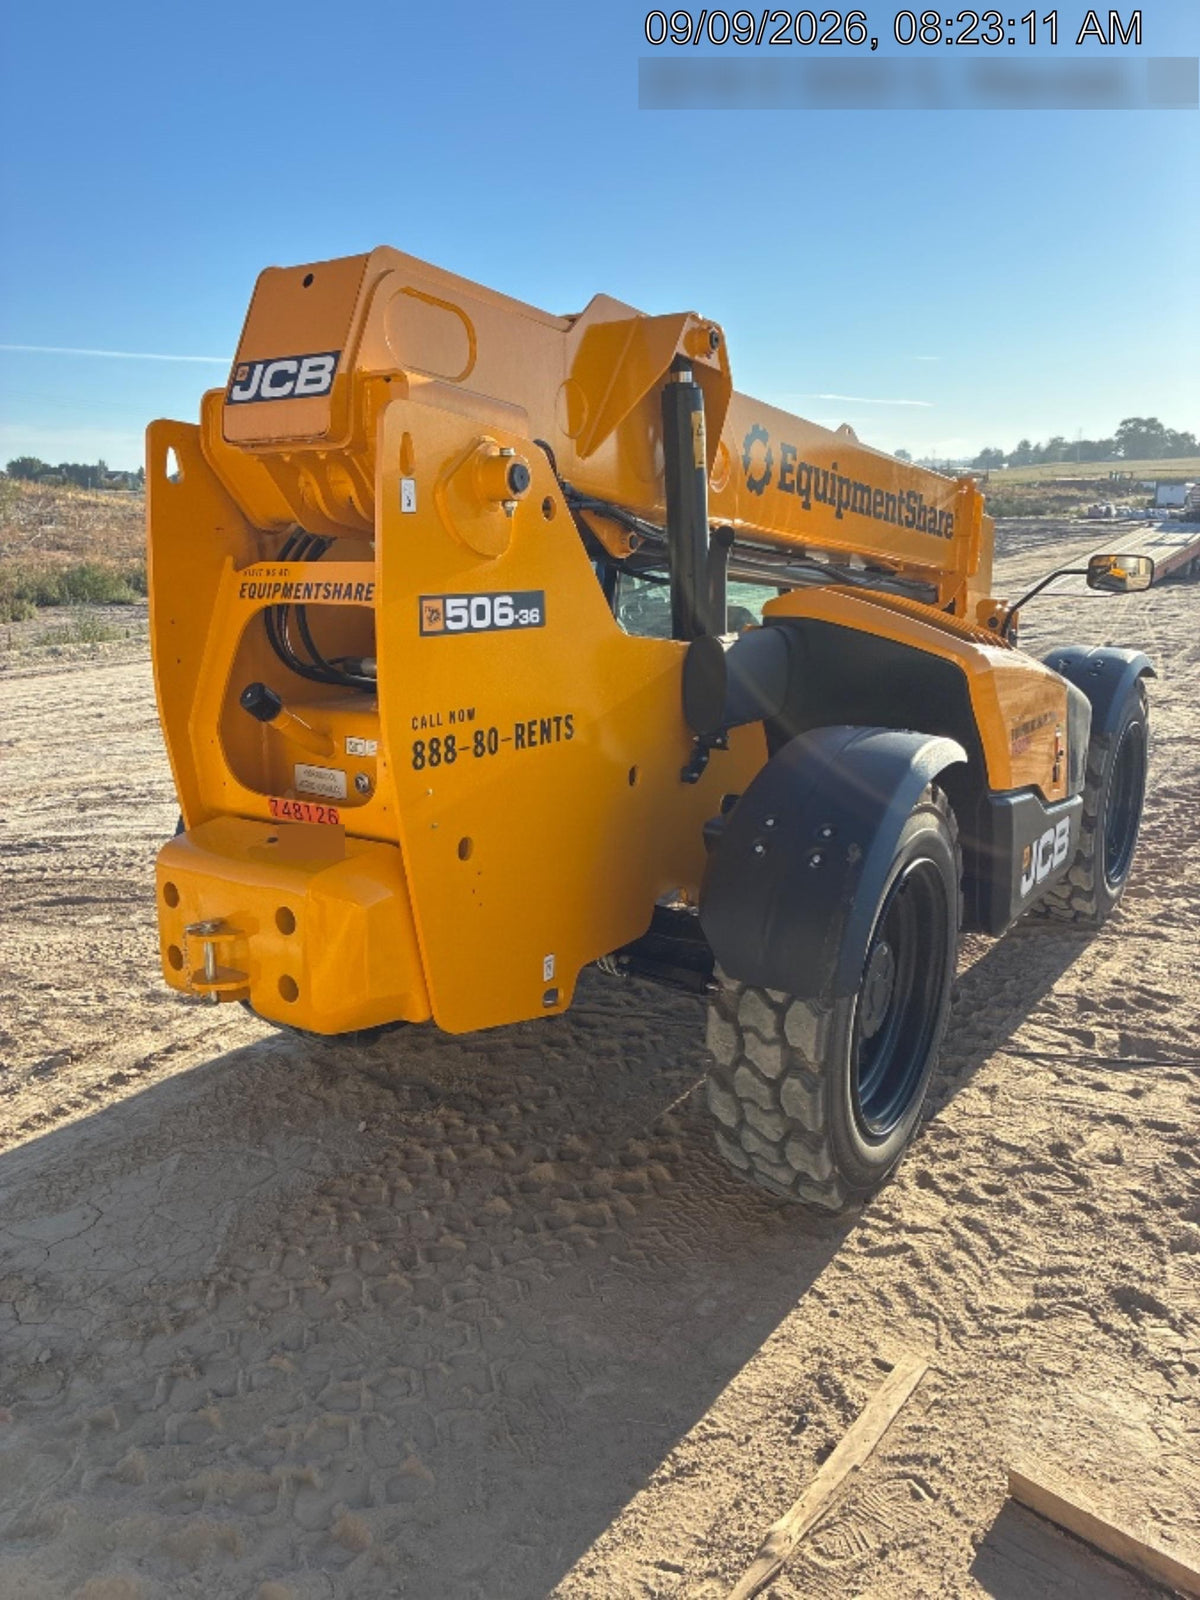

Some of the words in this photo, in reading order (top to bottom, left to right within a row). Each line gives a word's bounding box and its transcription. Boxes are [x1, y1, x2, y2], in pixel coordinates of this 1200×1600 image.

[231, 354, 336, 401] JCB
[777, 441, 954, 540] EquipmentShare
[239, 582, 376, 601] EQUIPMENTSHARE
[411, 713, 443, 731] CALL
[449, 707, 476, 724] NOW
[412, 714, 575, 771] 888-80-RENTS
[269, 799, 340, 825] 748126
[1020, 816, 1070, 898] JCB
